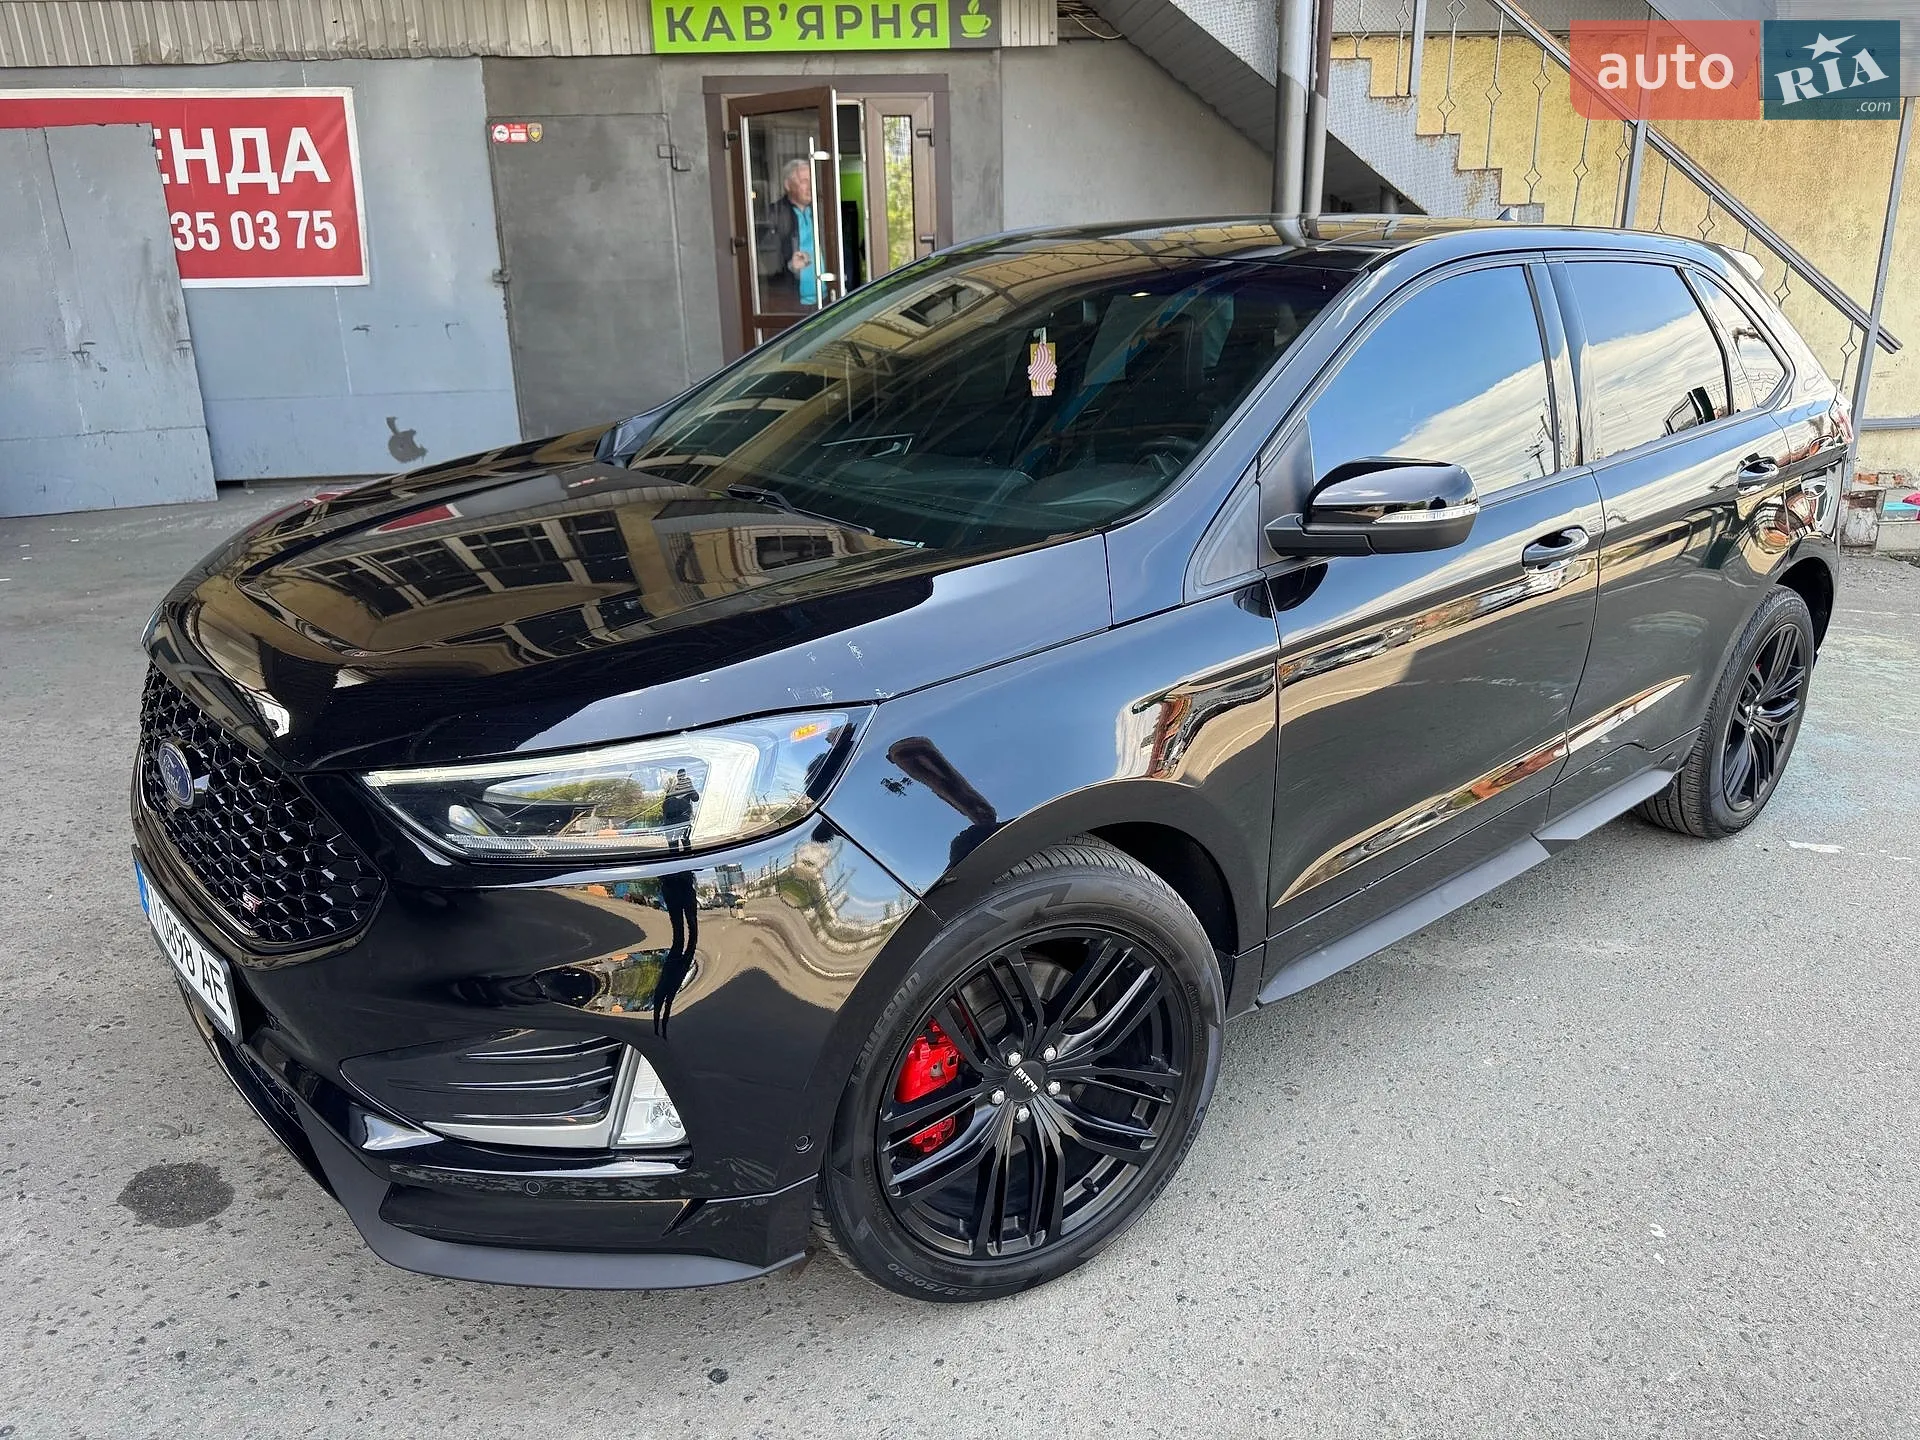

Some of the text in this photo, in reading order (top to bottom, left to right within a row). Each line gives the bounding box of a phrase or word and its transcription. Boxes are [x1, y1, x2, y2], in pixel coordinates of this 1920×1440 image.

[154, 127, 332, 195] НДА
[170, 210, 338, 252] 35 03 75
[158, 901, 196, 977] 0898
[199, 950, 228, 1016] AE
